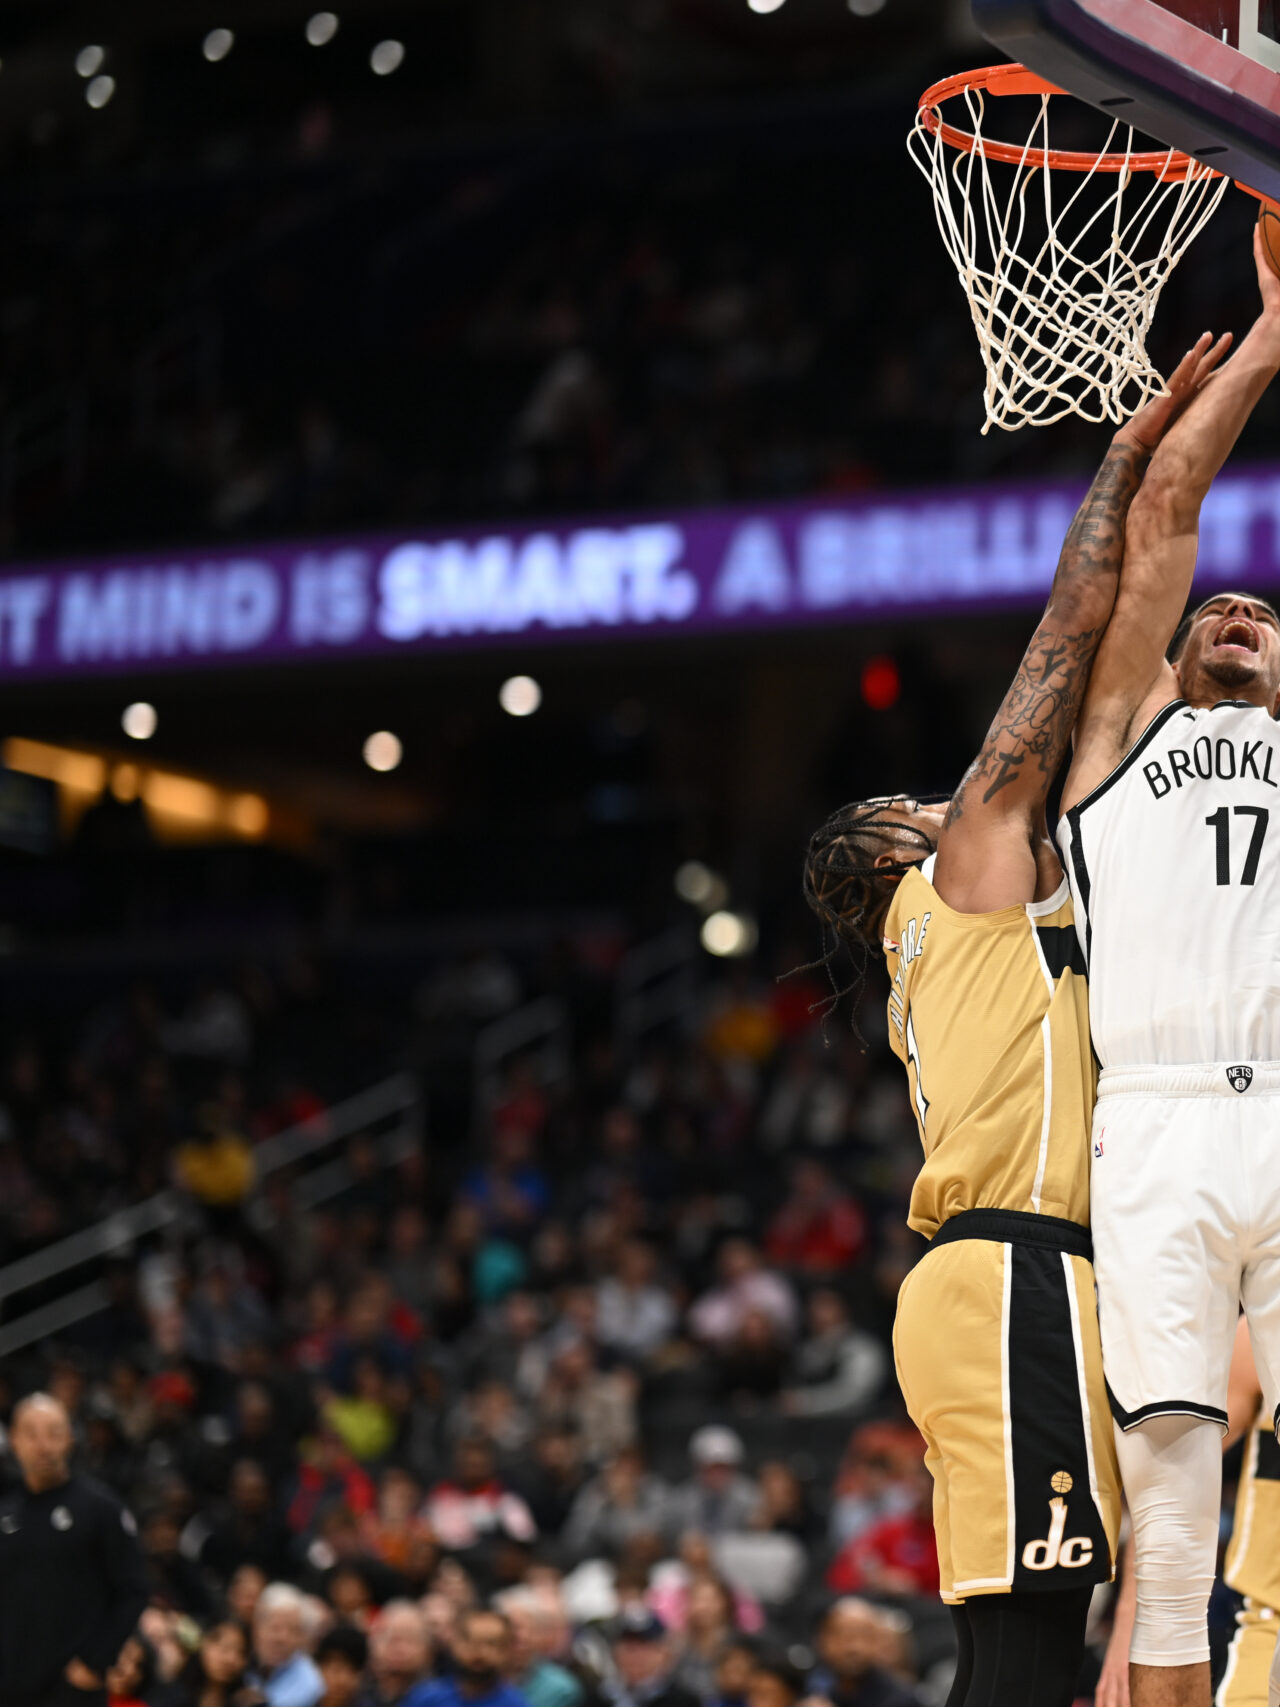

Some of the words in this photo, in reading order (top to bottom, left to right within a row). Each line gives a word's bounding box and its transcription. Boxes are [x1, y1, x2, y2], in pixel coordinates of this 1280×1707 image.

[58, 558, 279, 664] MIND
[293, 550, 371, 644] IS
[376, 521, 700, 641] SMART.
[715, 518, 791, 614] A
[1205, 805, 1270, 886] 17
[1228, 1066, 1252, 1078] NETS
